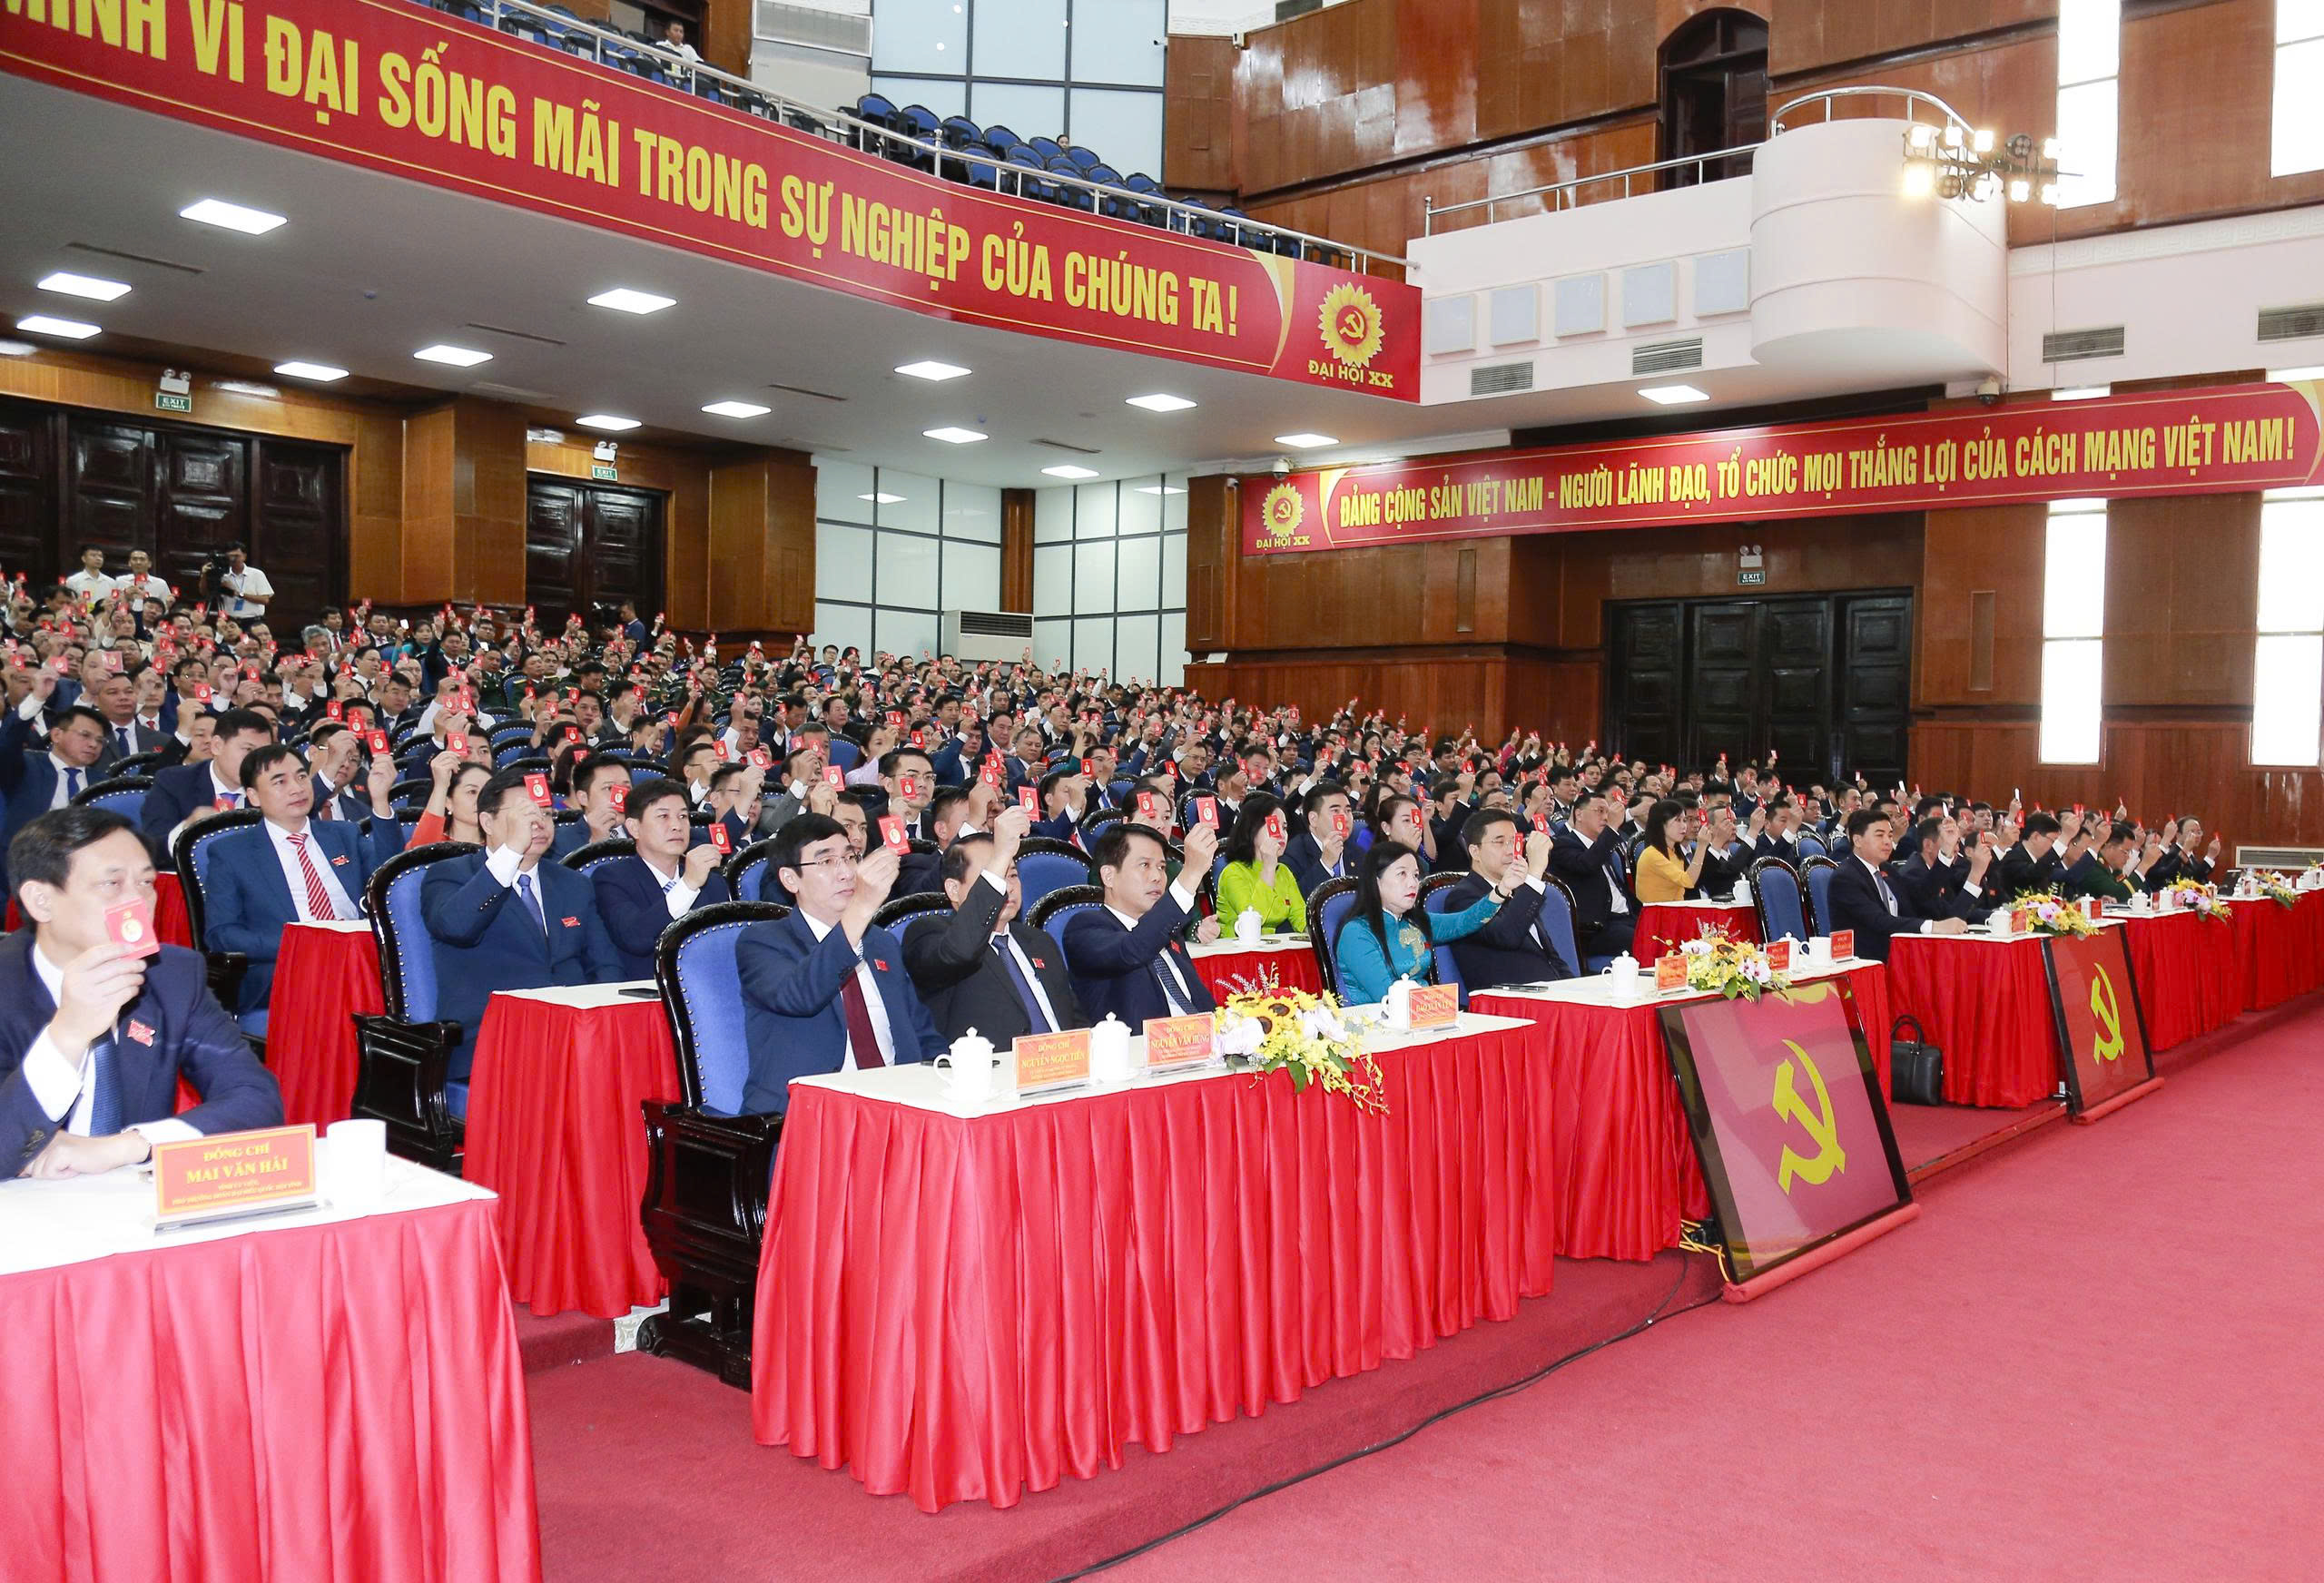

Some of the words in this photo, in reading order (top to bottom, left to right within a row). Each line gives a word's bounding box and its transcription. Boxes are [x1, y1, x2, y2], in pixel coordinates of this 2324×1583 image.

[263, 15, 359, 125] ĐẠI
[379, 42, 516, 159] SỐNG
[534, 99, 619, 187] MÃI
[635, 128, 768, 231] TRONG
[780, 174, 836, 260] SỰ
[841, 193, 970, 291] NGHIỆP
[981, 221, 1053, 302] CỦA
[1064, 251, 1179, 327] CHÚNG
[1188, 278, 1237, 335] TA!
[1308, 359, 1334, 380] ĐẠI
[1339, 364, 1364, 386] HỘI
[1369, 370, 1393, 388] XX
[163, 397, 186, 406] EXIT
[1339, 484, 1381, 527] ĐẢNG
[1384, 484, 1426, 529] CỘNG
[1430, 475, 1463, 520] SẢN
[1467, 475, 1501, 522] VIỆT
[1503, 477, 1543, 512] NAM
[1560, 463, 1613, 508] NGƯỜI
[1618, 462, 1665, 506] LÃNH
[1669, 464, 1711, 509] ĐẠO,
[1717, 446, 1744, 499] TỔ
[1746, 450, 1798, 497] CHỨC
[1804, 453, 1843, 499] MỌI
[1849, 434, 1917, 487] THẮNG
[1924, 438, 1957, 491] LỢI
[1964, 427, 2008, 480] CỦA
[2015, 427, 2077, 477] CÁCH
[2084, 428, 2156, 480] MẠNG
[2163, 416, 2216, 477] VIỆT
[2222, 417, 2295, 466] NAM!
[1256, 538, 1272, 551] ĐẠI
[1275, 536, 1291, 550] HỘI
[1294, 536, 1311, 546] XX
[203, 1146, 243, 1163] ĐỒNG
[245, 1142, 270, 1157] CHÍ
[186, 1167, 219, 1185] MAI
[222, 1161, 258, 1178] VĂN
[260, 1156, 289, 1175] HẢI
